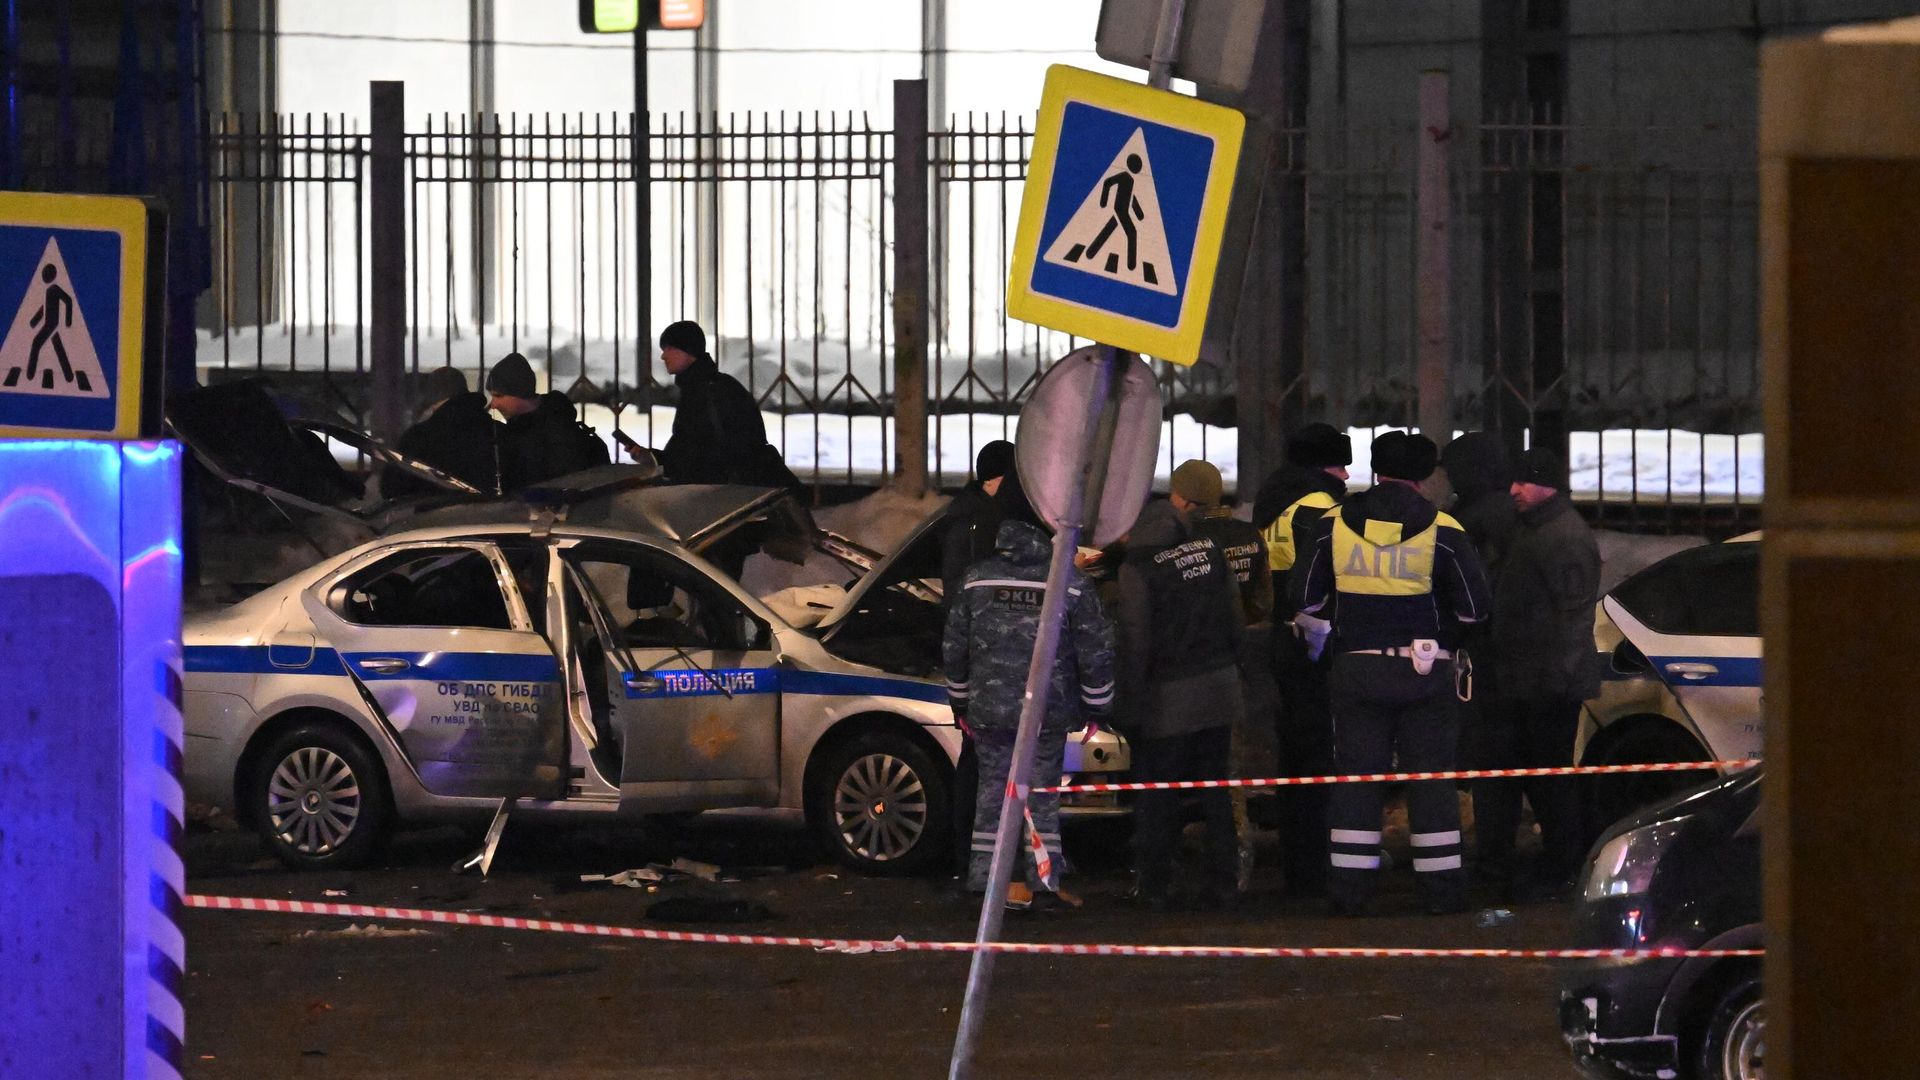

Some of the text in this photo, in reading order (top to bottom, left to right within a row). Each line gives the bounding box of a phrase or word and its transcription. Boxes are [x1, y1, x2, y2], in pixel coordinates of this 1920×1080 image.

[1344, 543, 1423, 579] ДПС
[999, 589, 1037, 604] ЭКЦ
[437, 682, 459, 696] ОБ
[464, 683, 497, 698] ДПС
[664, 671, 755, 694] ПОЛИЦИЯ
[453, 699, 480, 713] УВД
[502, 701, 541, 713] СВАО
[444, 715, 466, 725] МВД
